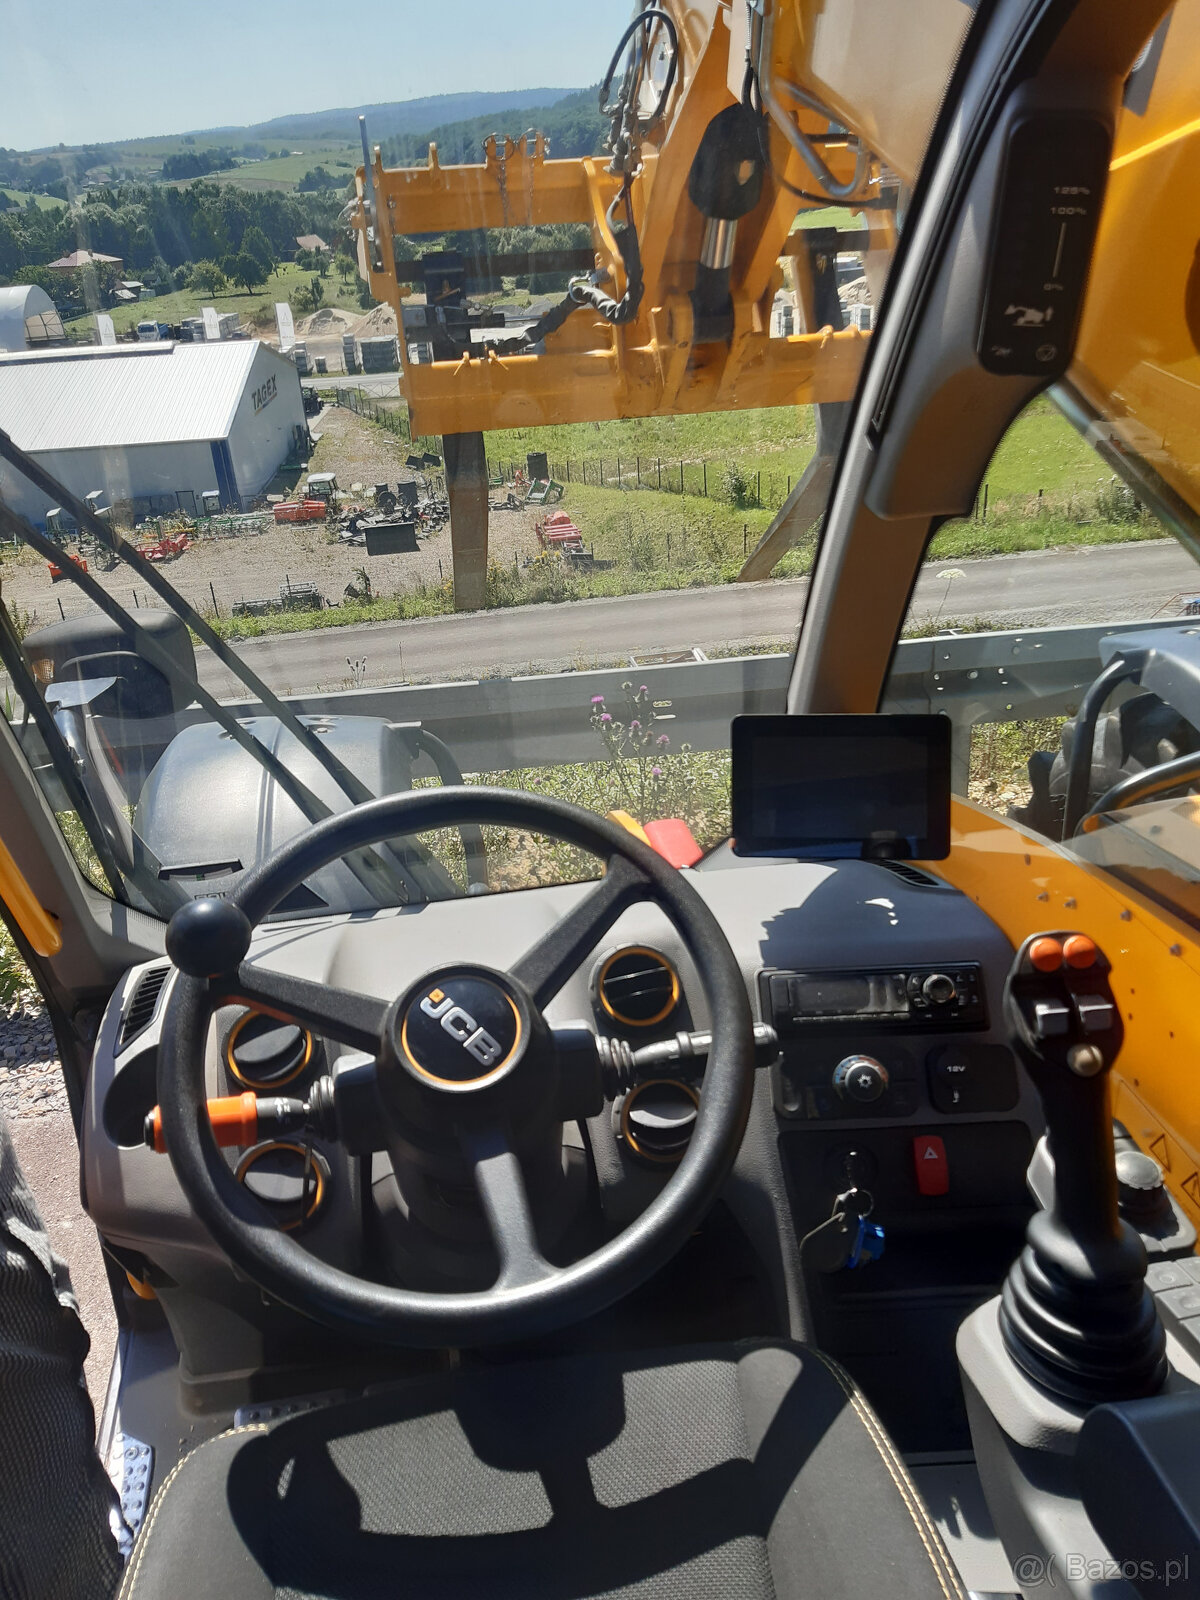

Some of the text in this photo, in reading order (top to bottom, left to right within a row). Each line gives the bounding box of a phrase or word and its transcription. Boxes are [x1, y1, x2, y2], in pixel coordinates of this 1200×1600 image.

[252, 374, 277, 410] TAGEX
[420, 988, 502, 1067] JCB
[946, 1065, 966, 1073] 12V
